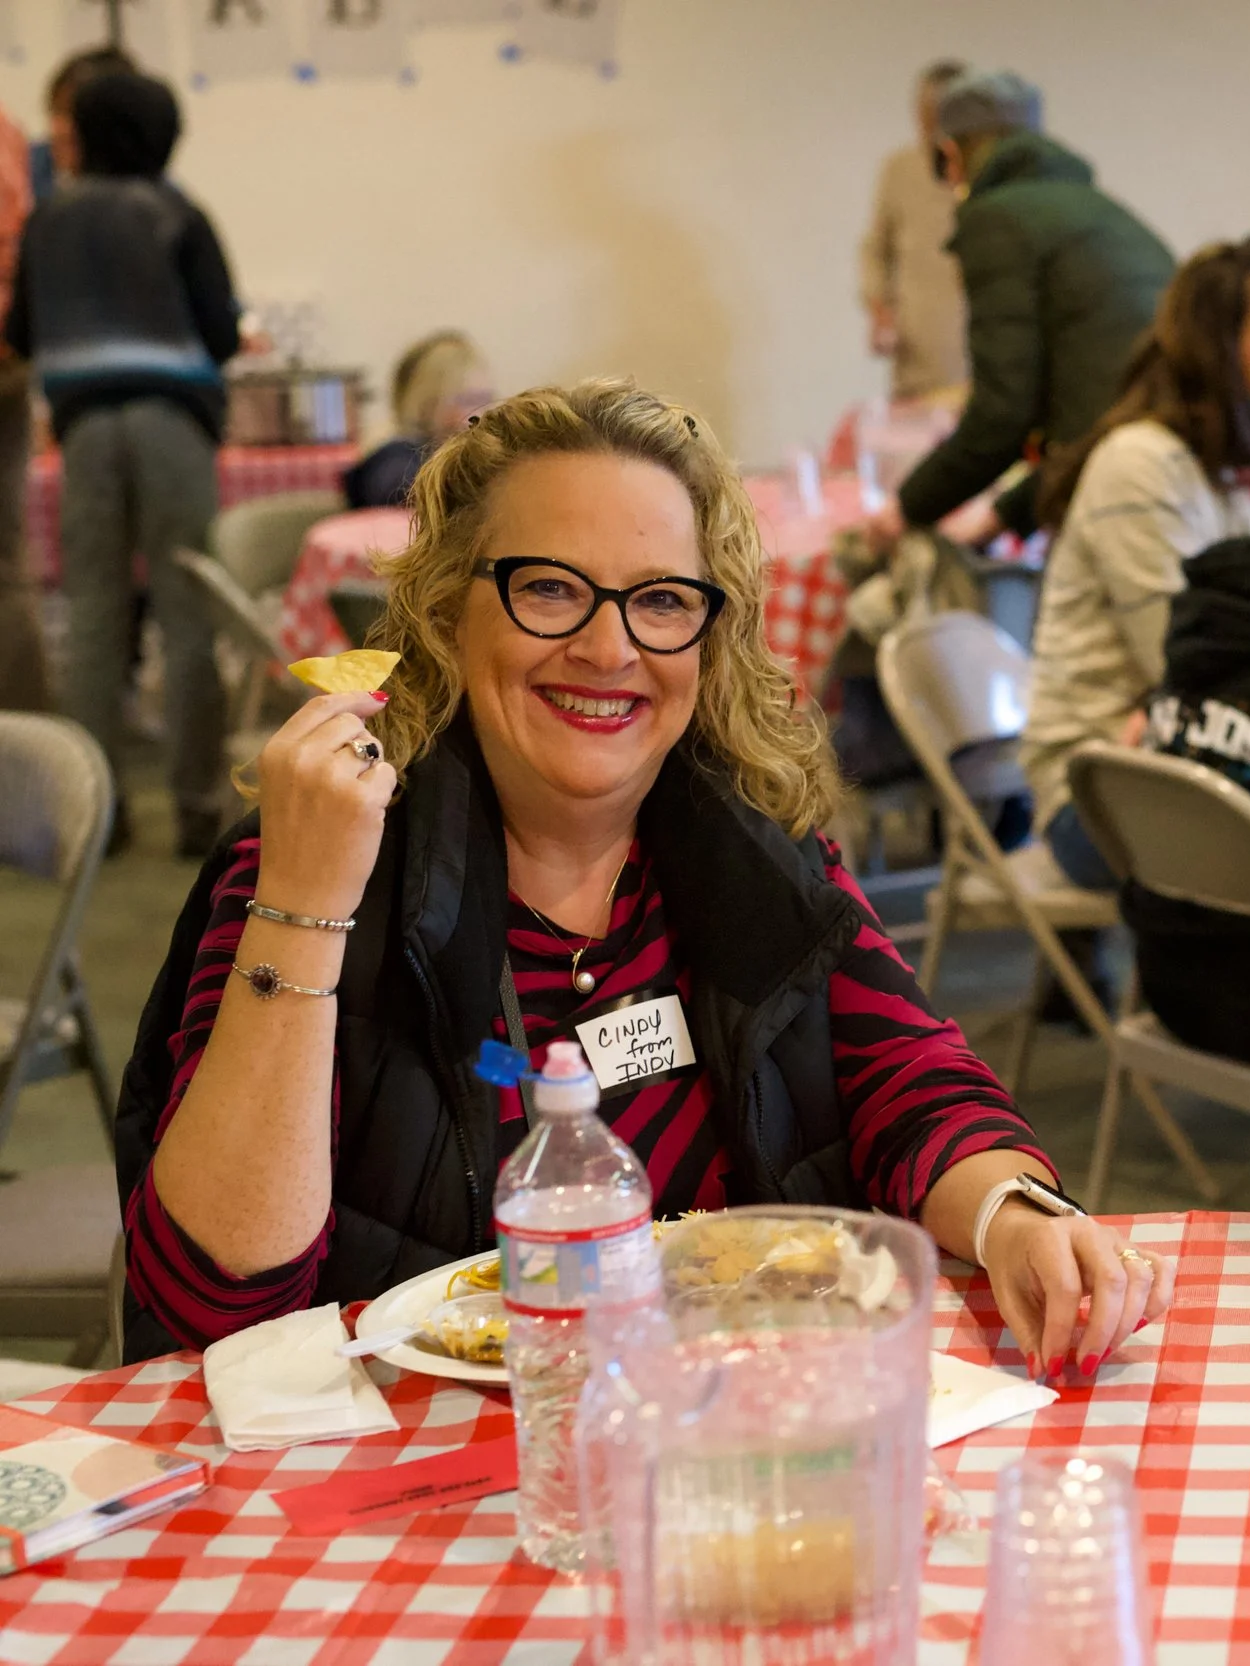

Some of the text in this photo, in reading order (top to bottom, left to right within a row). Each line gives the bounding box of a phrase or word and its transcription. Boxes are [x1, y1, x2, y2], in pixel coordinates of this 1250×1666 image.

[598, 1009, 661, 1048] CINDY
[626, 1036, 672, 1058] from
[615, 1049, 675, 1082] INDY
